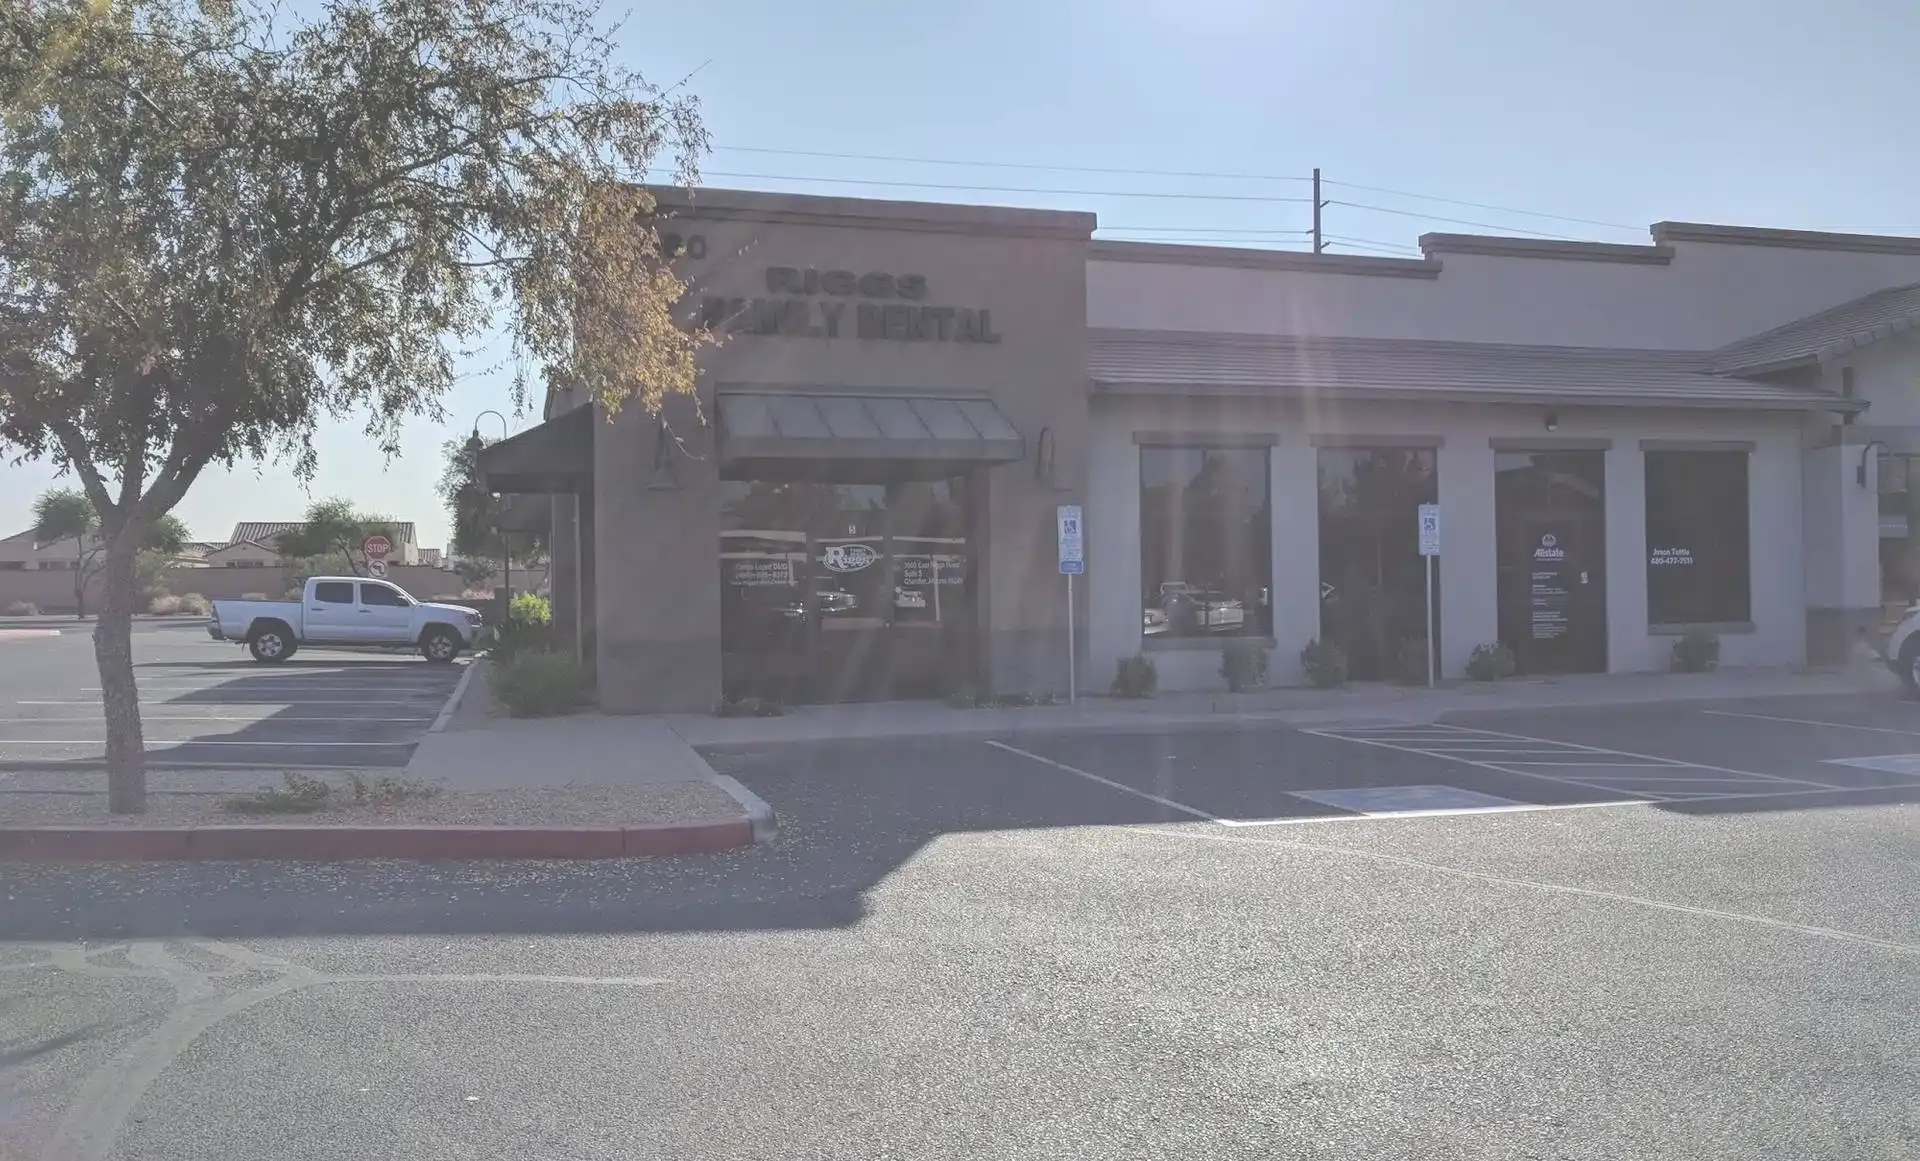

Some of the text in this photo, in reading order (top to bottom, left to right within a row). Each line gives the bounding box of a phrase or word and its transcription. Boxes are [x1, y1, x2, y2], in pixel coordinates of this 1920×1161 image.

[766, 266, 929, 299] RIGGS
[857, 304, 1002, 344] DENTAL
[367, 543, 389, 553] STOP
[1534, 548, 1564, 557] Allstate
